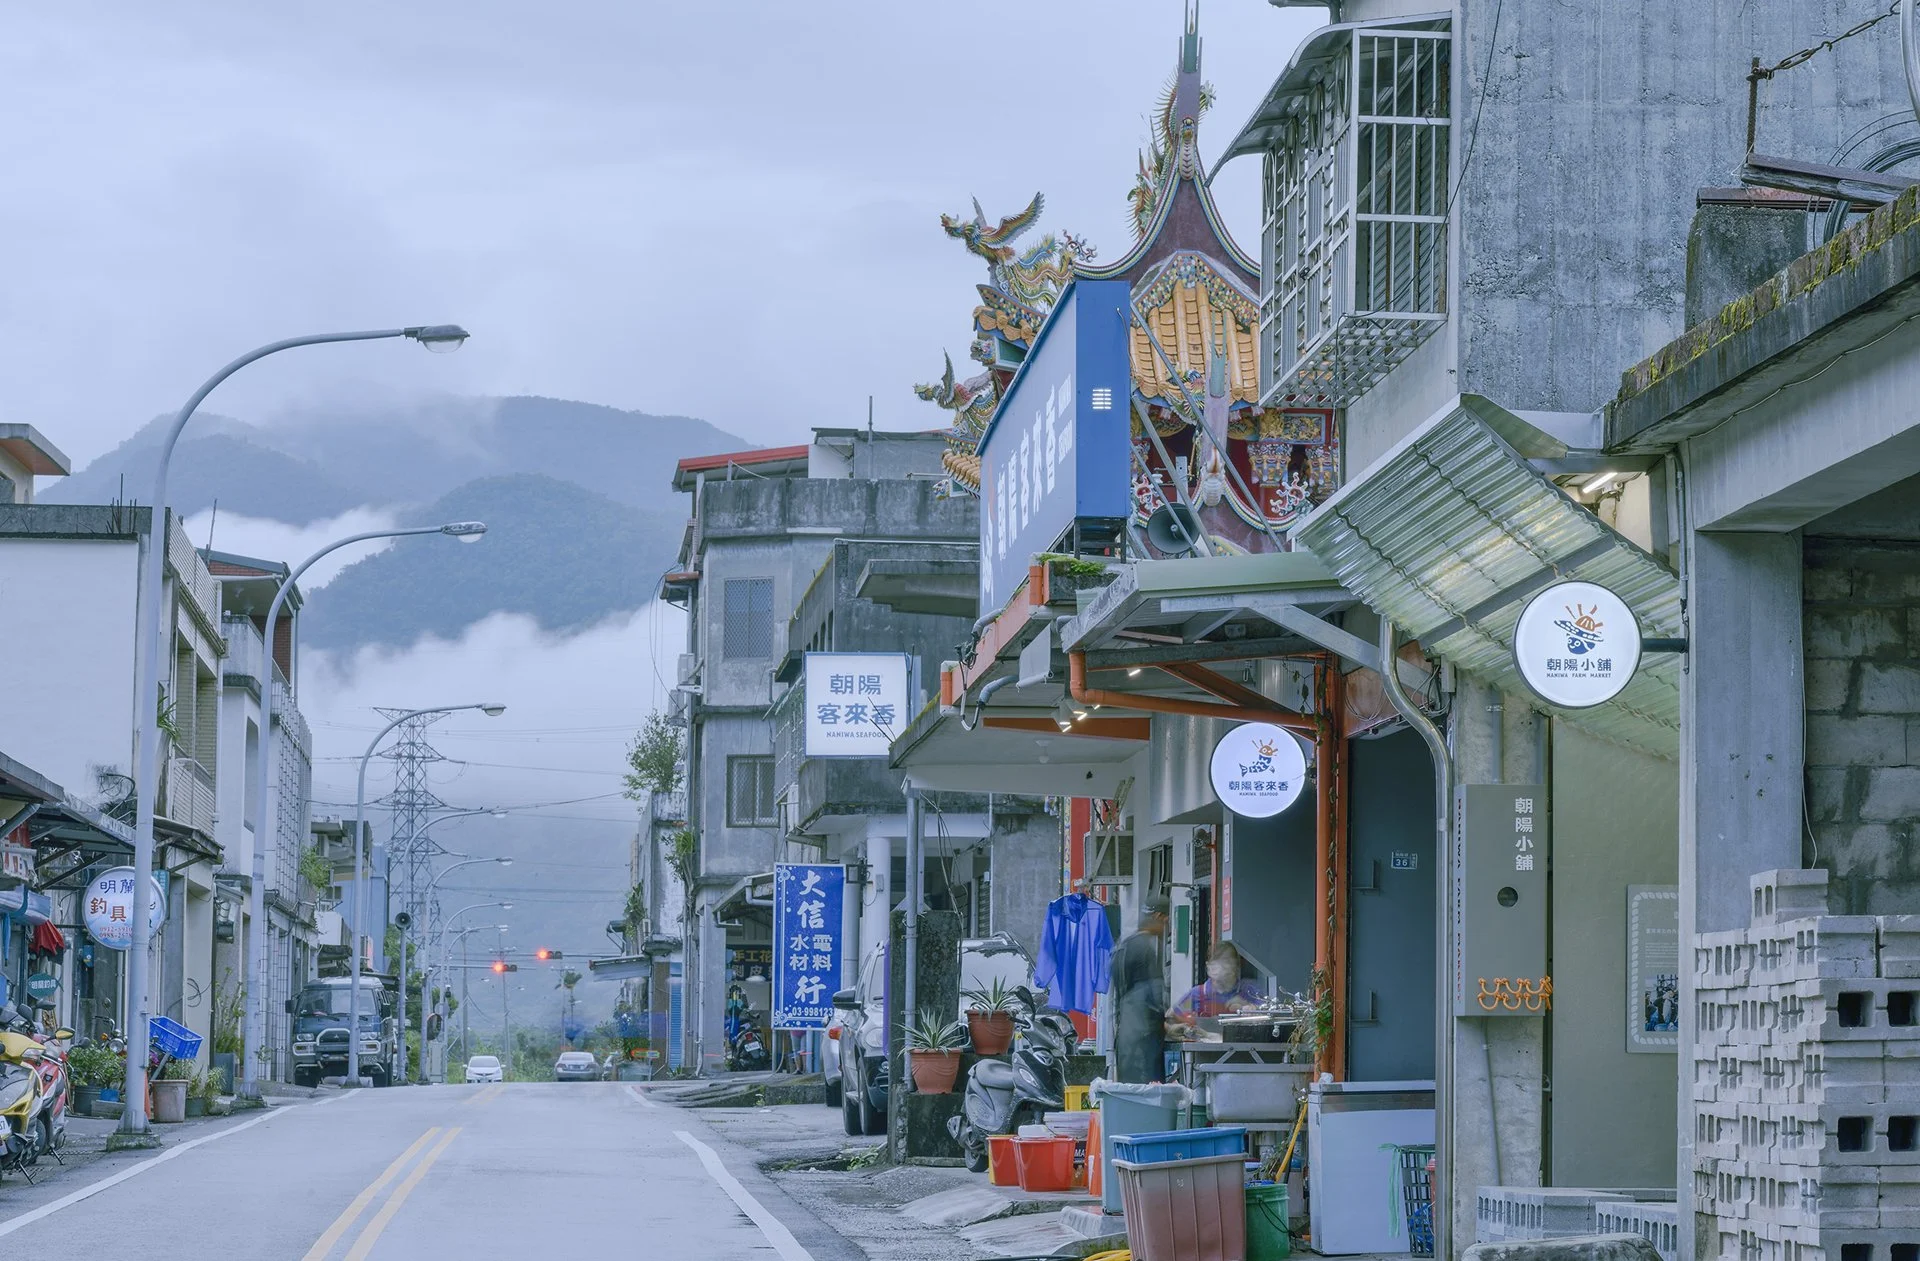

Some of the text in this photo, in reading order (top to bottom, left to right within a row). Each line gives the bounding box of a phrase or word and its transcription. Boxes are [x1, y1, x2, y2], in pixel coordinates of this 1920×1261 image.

[1547, 658, 1611, 671] 朝陽小舖
[830, 674, 881, 695] 朝陽
[817, 703, 896, 725] 客來香
[1229, 781, 1288, 791] 朝陽客來香
[1515, 798, 1534, 870] 朝陽小舖
[1395, 858, 1408, 867] 36
[90, 897, 127, 922] 釣具
[797, 870, 826, 929] 大信
[792, 1006, 834, 1016] 03-998123
